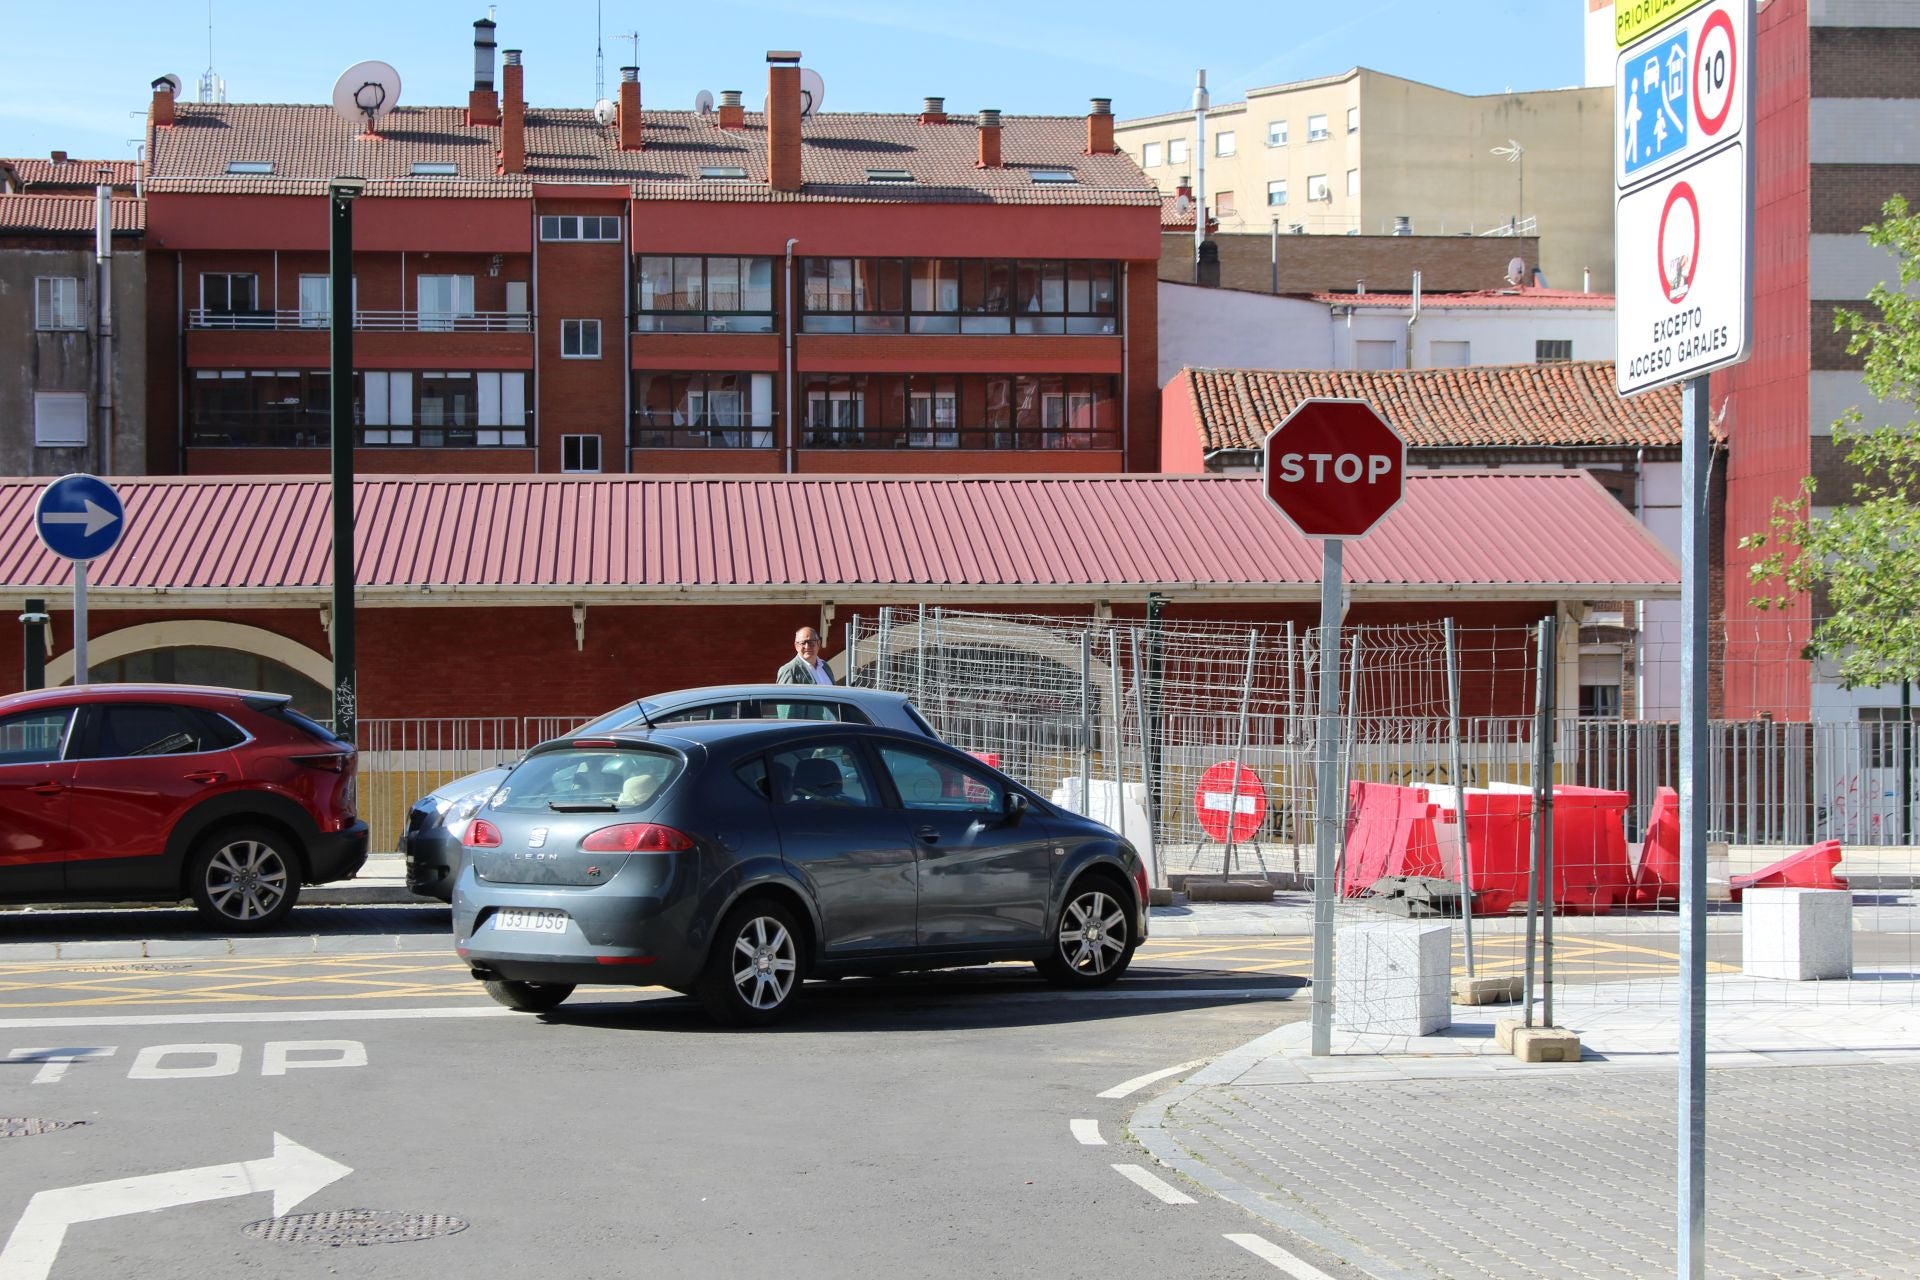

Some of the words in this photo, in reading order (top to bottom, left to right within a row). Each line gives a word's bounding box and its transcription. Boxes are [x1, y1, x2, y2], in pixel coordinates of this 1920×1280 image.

[1617, 0, 1676, 35] PRIORIDA
[1705, 49, 1725, 94] 10
[1653, 306, 1702, 343] EXCEPTO
[1629, 346, 1672, 380] ACCESO
[1677, 325, 1728, 362] GARAJES
[1279, 453, 1392, 484] STOP
[501, 909, 533, 928] 1331
[535, 911, 565, 930] DSG
